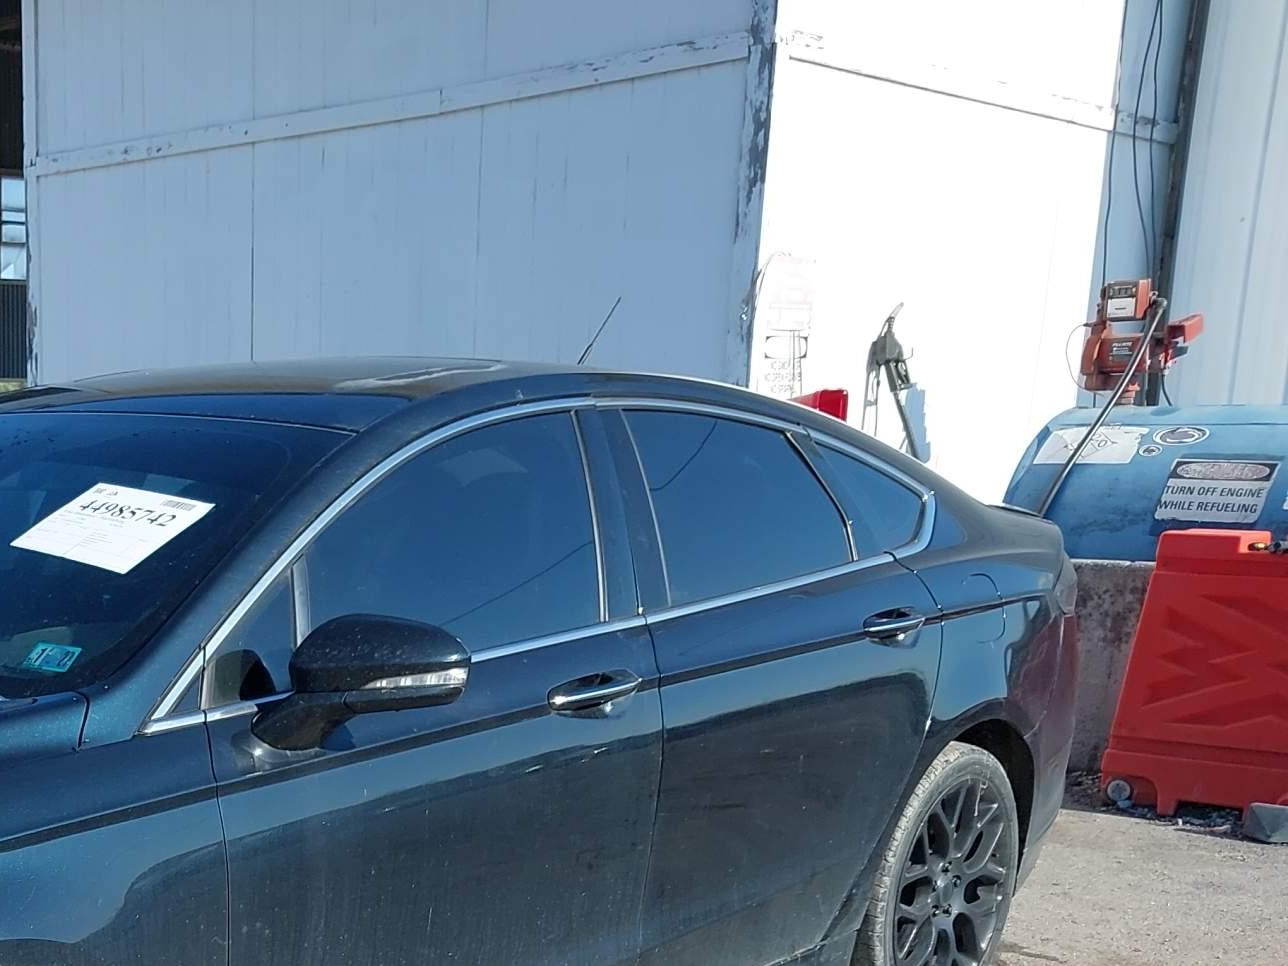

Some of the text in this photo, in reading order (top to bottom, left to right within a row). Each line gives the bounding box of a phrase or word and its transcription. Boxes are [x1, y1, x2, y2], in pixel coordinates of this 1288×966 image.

[1165, 485, 1265, 499] TURN OFF ENGINE
[79, 499, 177, 527] 44985742
[1158, 500, 1259, 514] WHILE REFUELING
